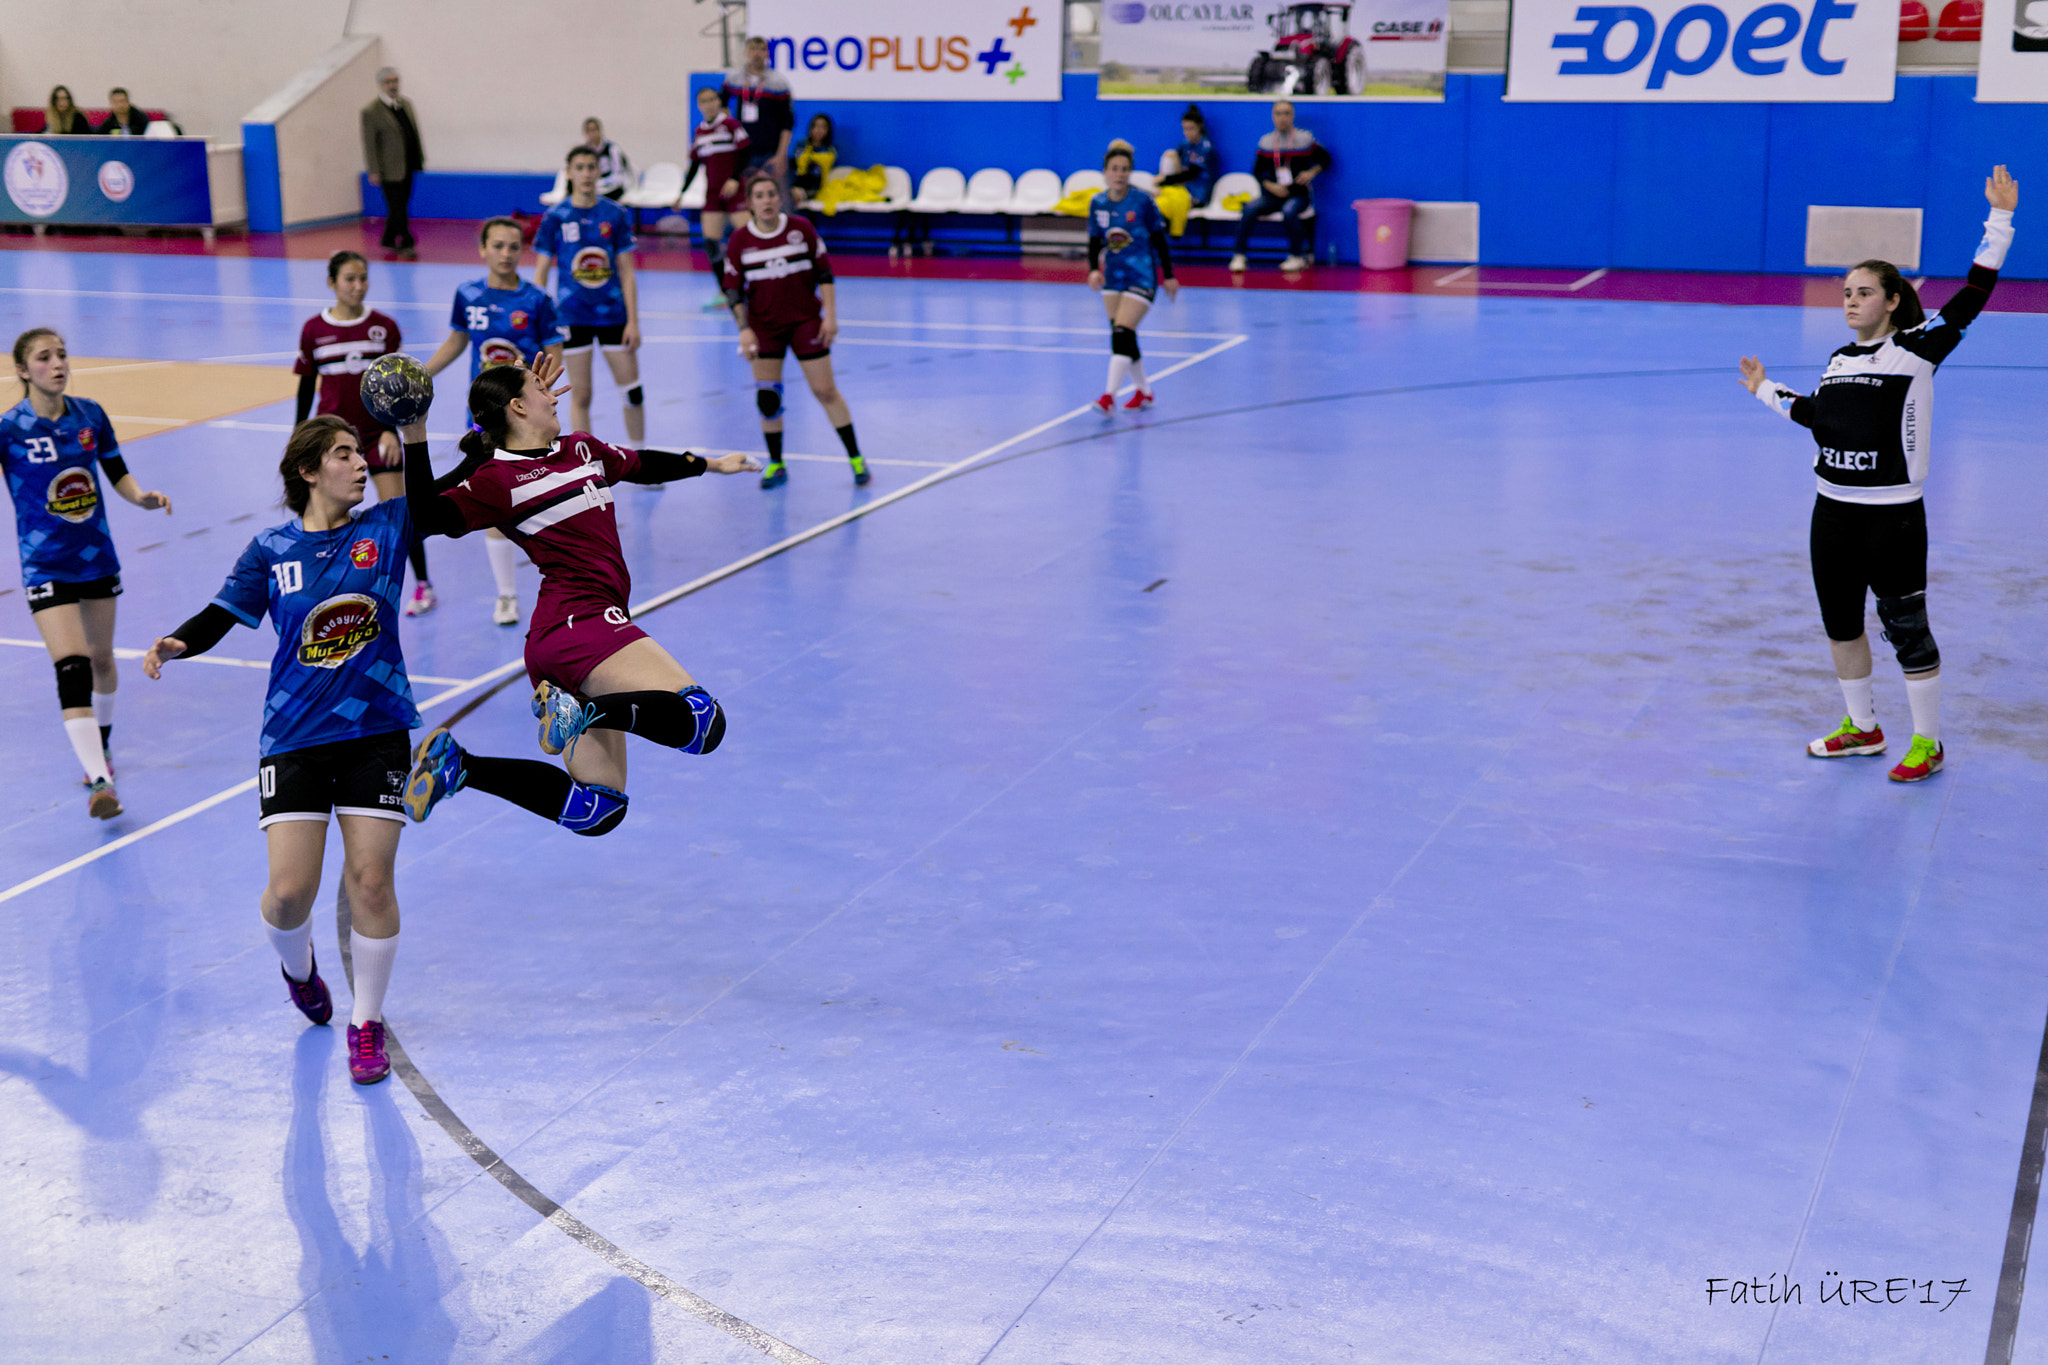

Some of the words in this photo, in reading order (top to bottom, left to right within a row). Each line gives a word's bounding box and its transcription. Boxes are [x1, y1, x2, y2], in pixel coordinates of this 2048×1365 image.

[1373, 21, 1423, 33] CASE
[466, 305, 489, 331] 35
[1905, 399, 1916, 452] HENTBOL
[25, 436, 58, 463] 23
[583, 479, 607, 512] 4
[272, 560, 303, 598] 10
[260, 765, 276, 800] 10
[379, 794, 406, 806] ESY
